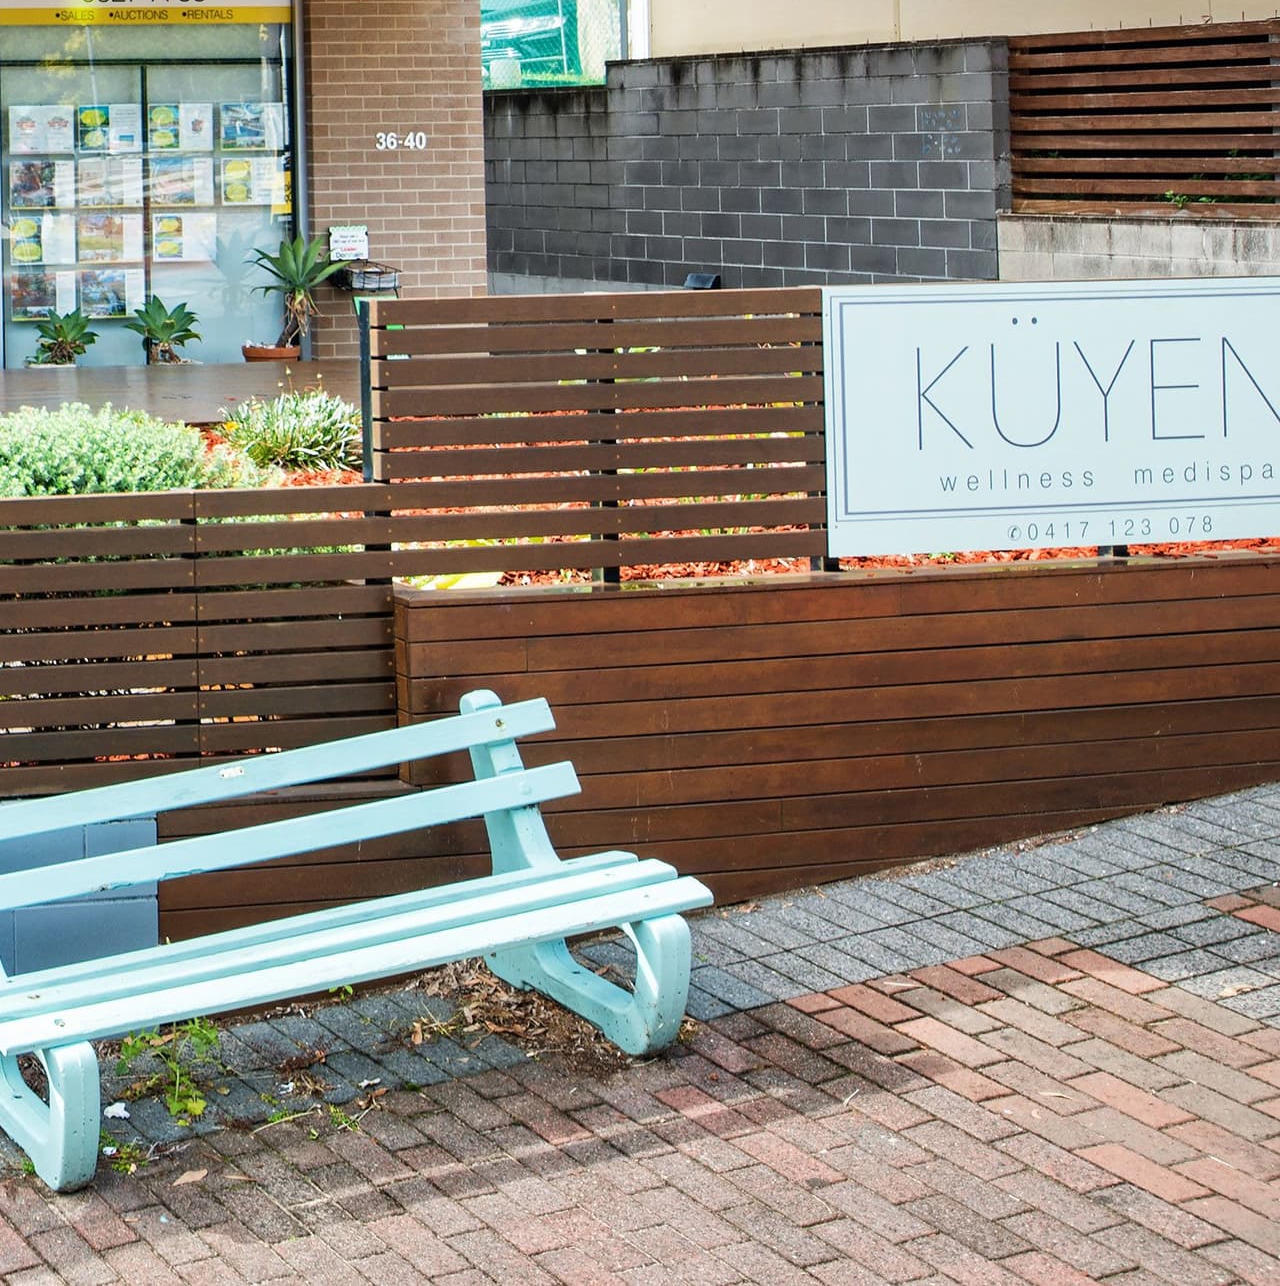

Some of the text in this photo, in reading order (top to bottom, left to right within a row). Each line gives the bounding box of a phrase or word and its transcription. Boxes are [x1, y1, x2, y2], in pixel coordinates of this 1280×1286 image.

[61, 10, 234, 21] SALES AUCTIONS RENTALS
[375, 132, 427, 150] 36-40
[915, 316, 1280, 451] KÜYEN
[940, 458, 1275, 492] wellness medispa
[1027, 514, 1214, 542] 0417 123 078
